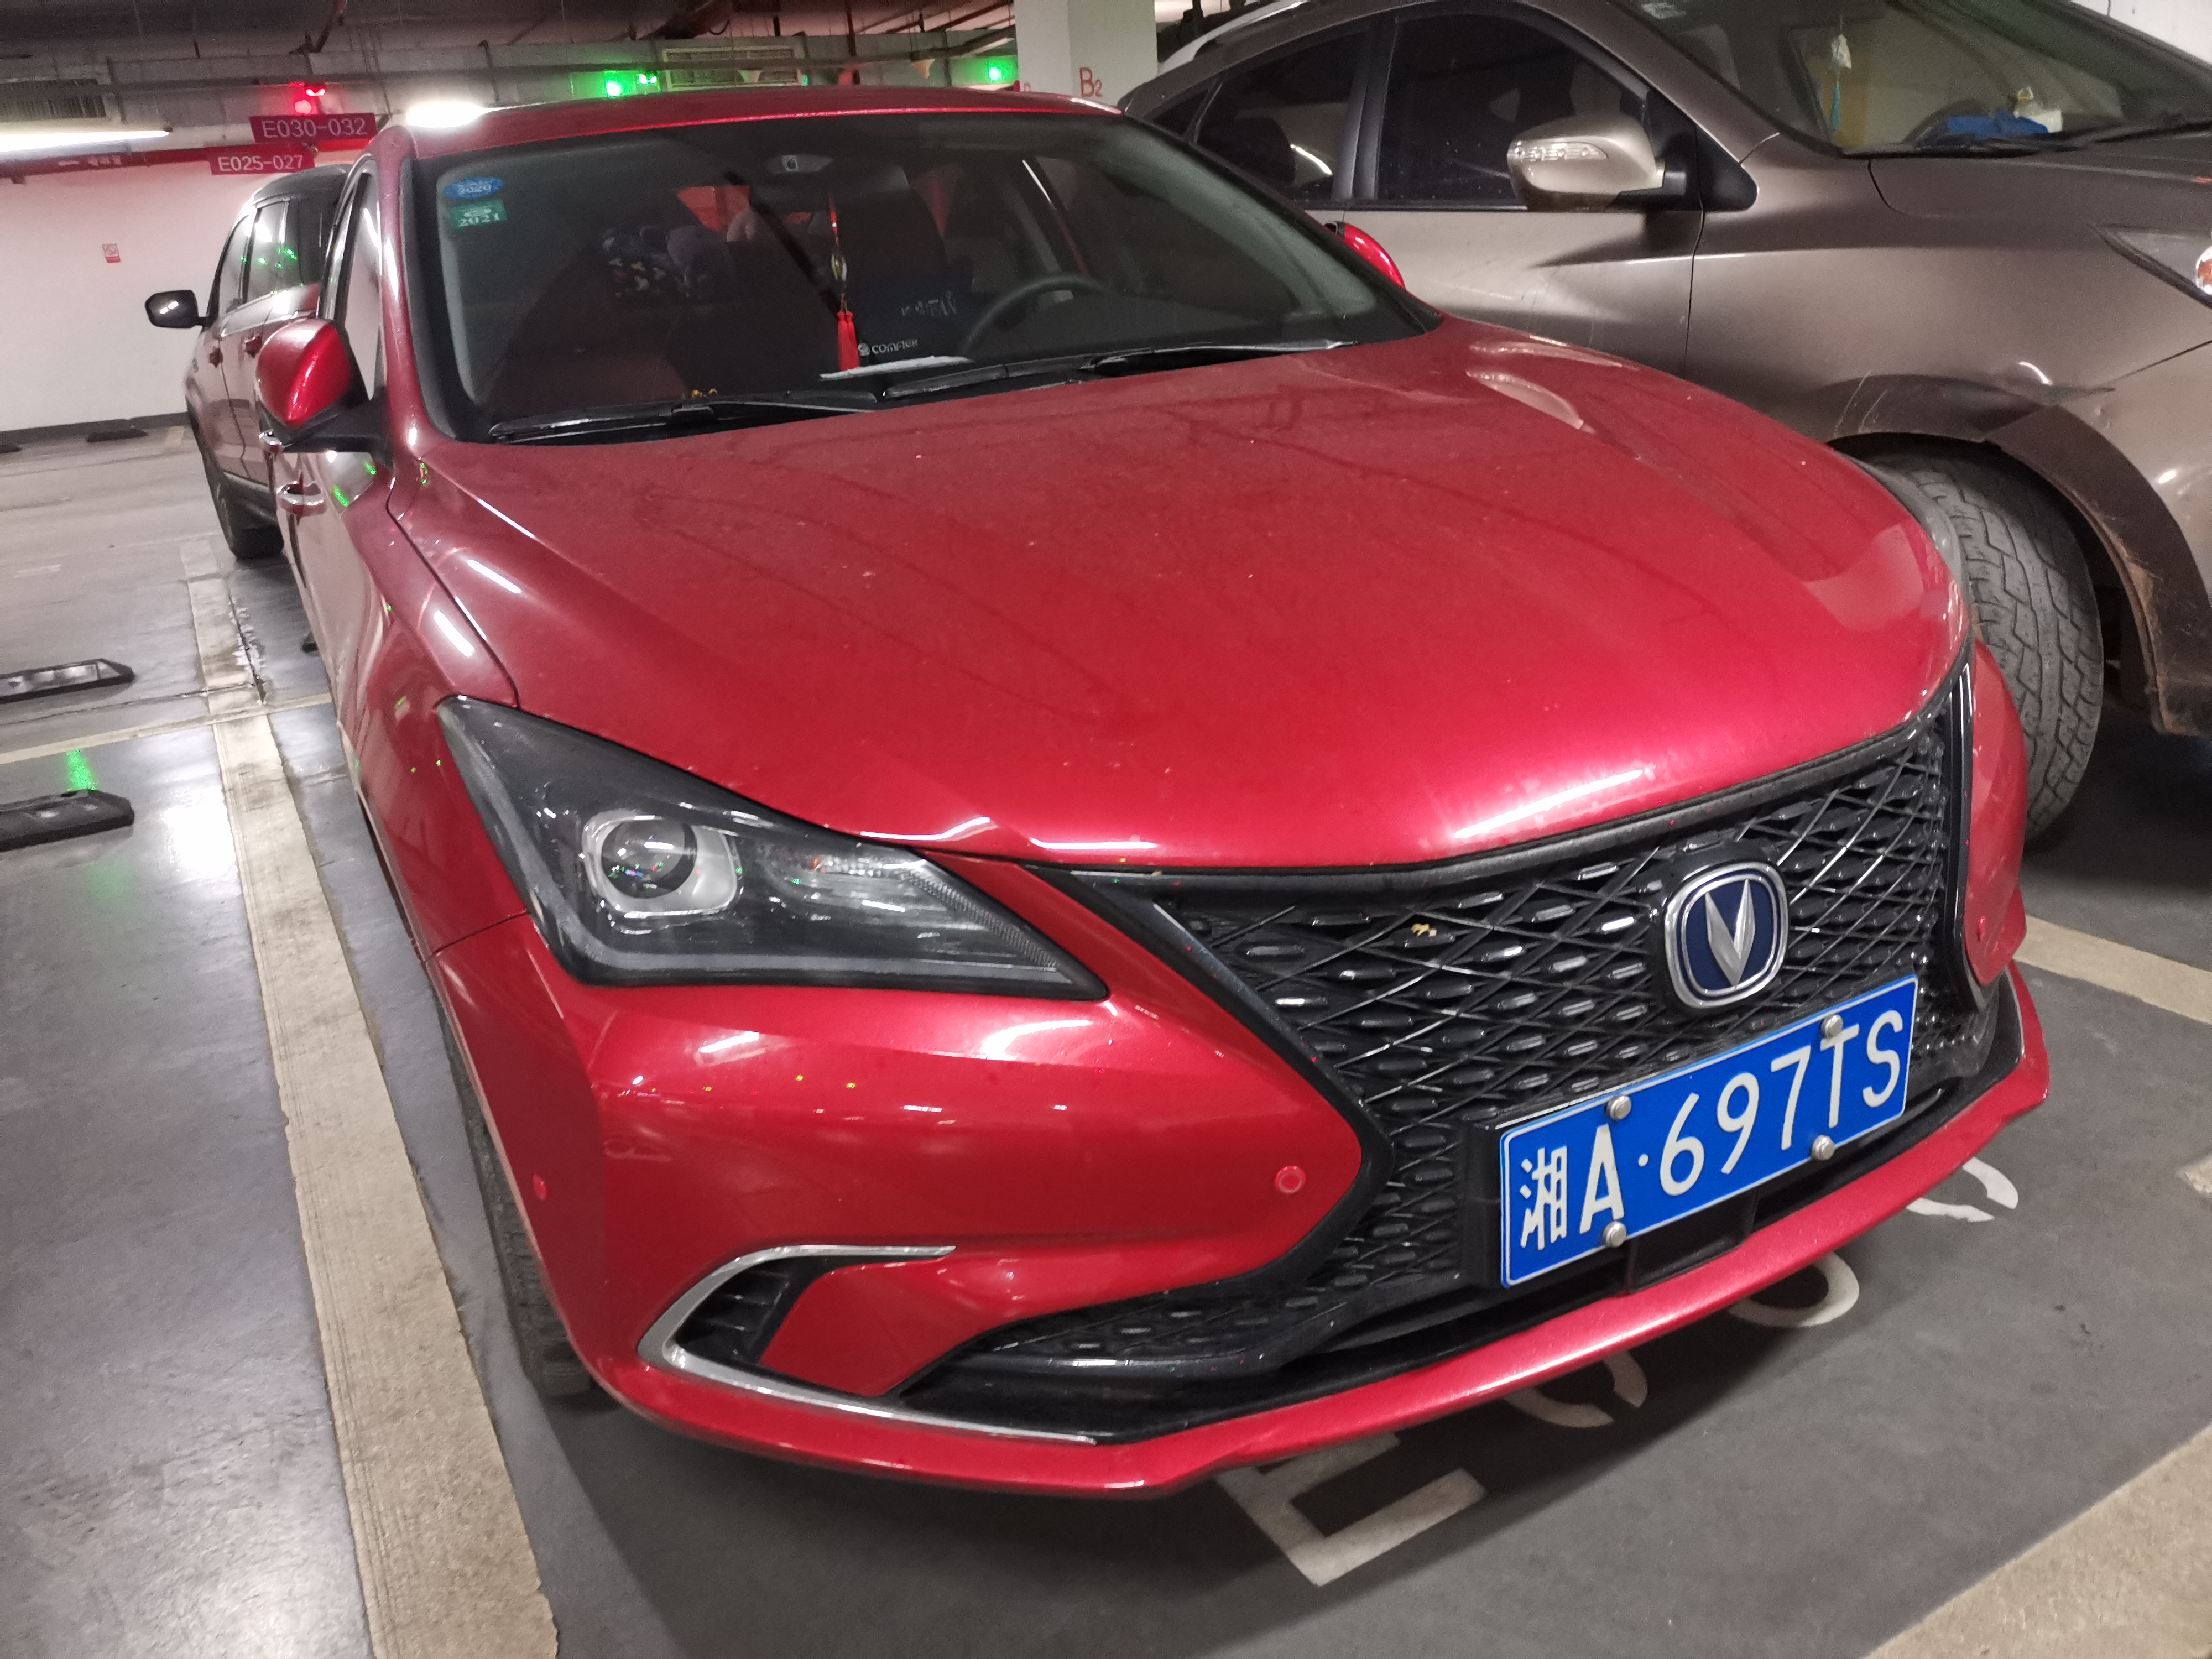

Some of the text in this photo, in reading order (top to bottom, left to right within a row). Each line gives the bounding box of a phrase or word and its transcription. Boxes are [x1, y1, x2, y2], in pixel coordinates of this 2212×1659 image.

[261, 117, 367, 138] E030-032
[217, 155, 304, 171] E025-027
[458, 212, 500, 227] 2021
[1519, 1010, 1903, 1250] 湘A·697TS
